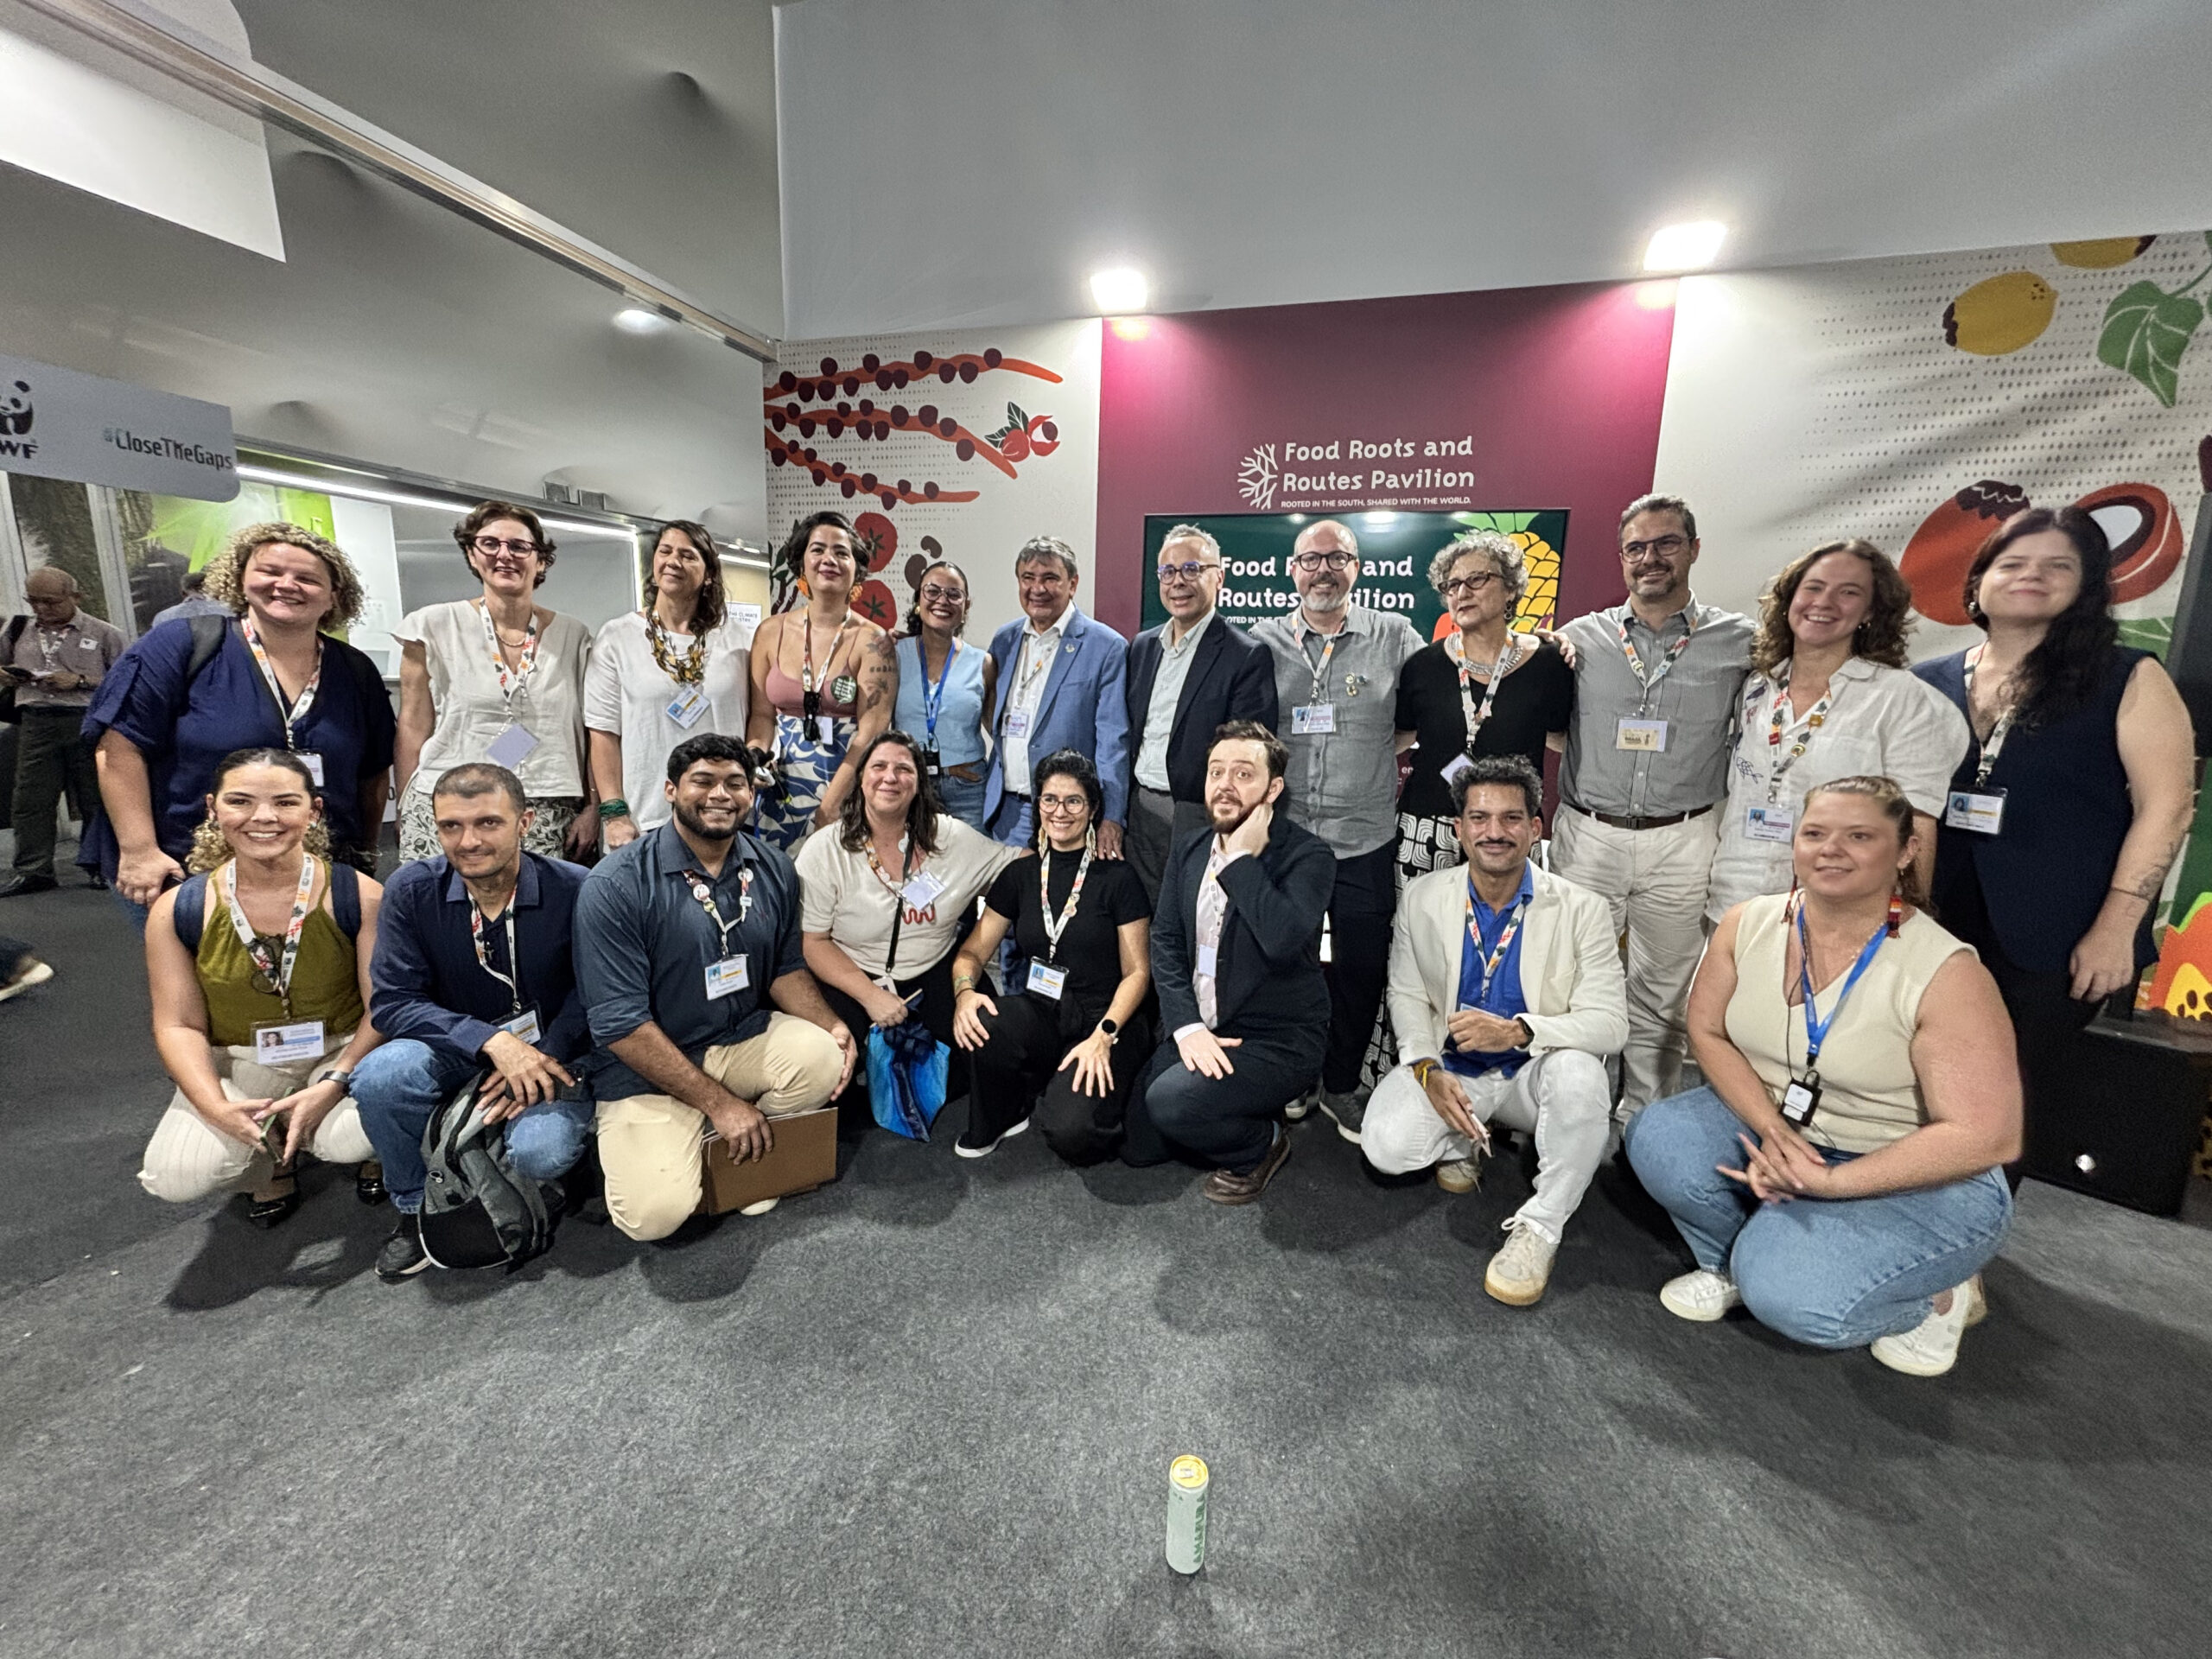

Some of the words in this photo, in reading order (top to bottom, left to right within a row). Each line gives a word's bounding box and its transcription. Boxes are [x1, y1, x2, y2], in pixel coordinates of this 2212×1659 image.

[103, 427, 233, 470] #CloseTheGaps
[1285, 441, 1340, 461] Food
[1349, 438, 1415, 459] Roots
[1423, 435, 1473, 456] and
[1283, 472, 1363, 492] Routes
[1370, 468, 1474, 489] Pavilion
[1221, 556, 1276, 576] Food
[1362, 556, 1414, 576] and
[1218, 588, 1300, 607] Routes
